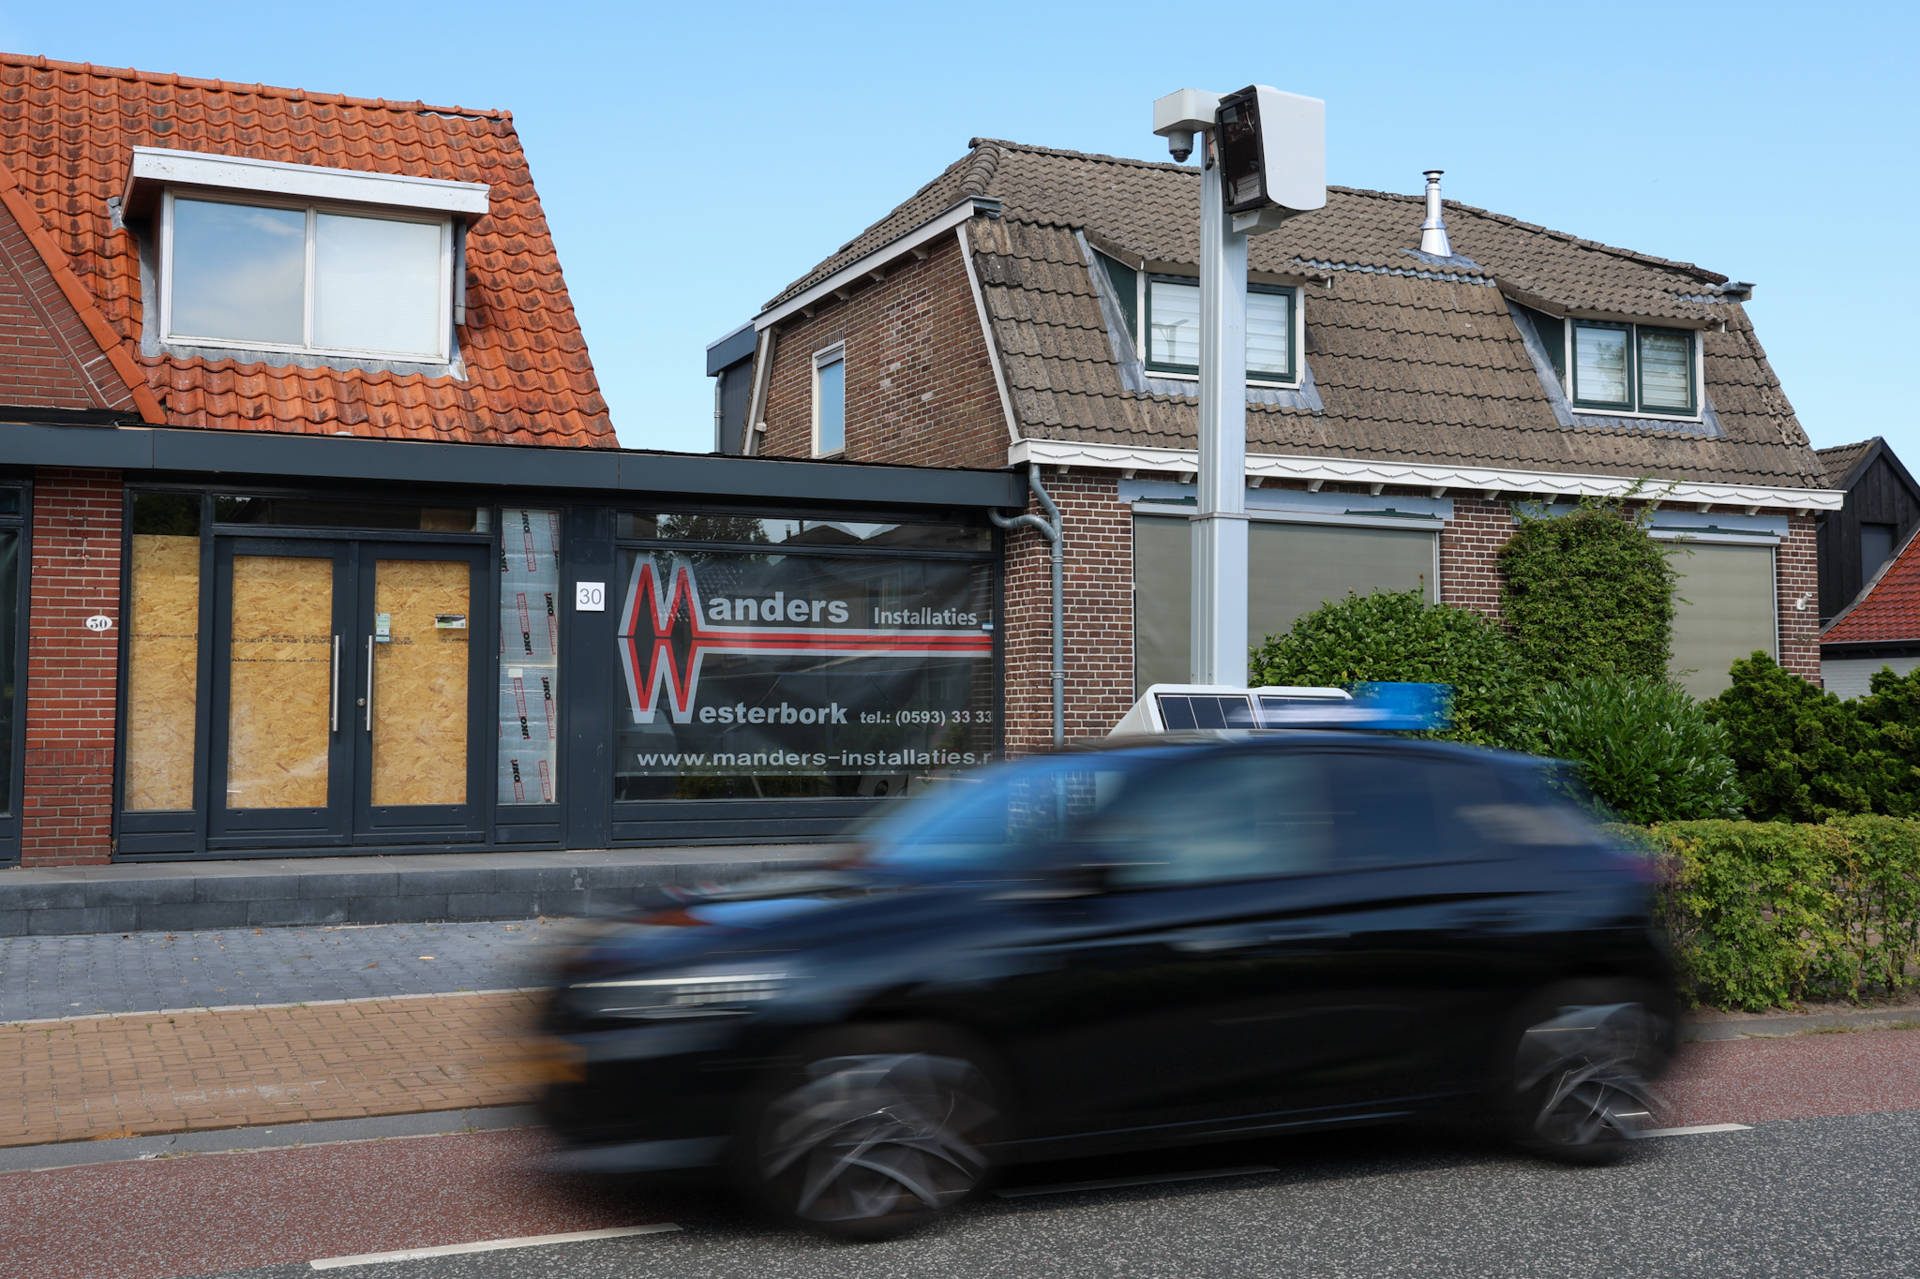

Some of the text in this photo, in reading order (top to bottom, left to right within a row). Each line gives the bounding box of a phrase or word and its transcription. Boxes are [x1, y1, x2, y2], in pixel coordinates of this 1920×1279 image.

[579, 588, 602, 605] 30
[618, 553, 849, 637] Manders
[873, 607, 978, 627] Installaties
[618, 638, 848, 724] Westerbork
[895, 710, 946, 727] (0593)
[951, 710, 971, 723] 33
[975, 710, 992, 723] 33
